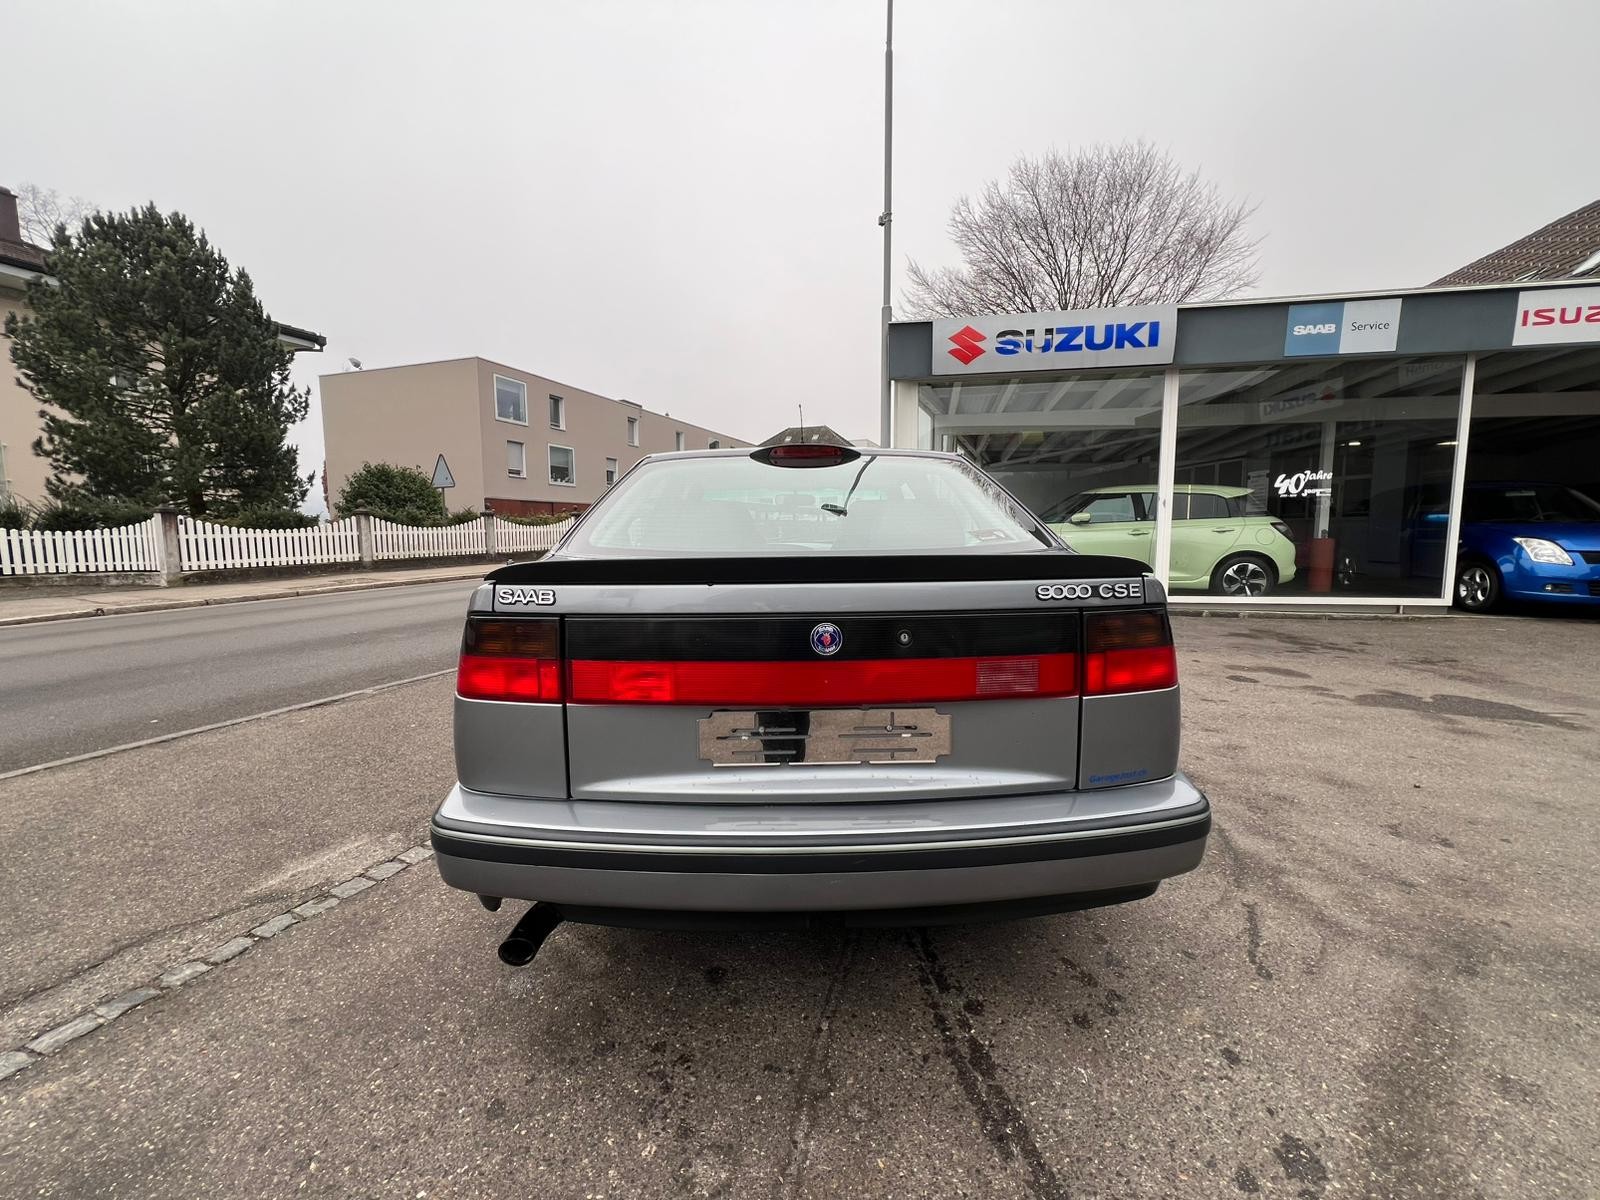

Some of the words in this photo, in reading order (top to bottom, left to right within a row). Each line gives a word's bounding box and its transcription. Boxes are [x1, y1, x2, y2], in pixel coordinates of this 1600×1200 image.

[1293, 323, 1336, 336] SAAB
[1351, 321, 1390, 332] Service
[995, 321, 1160, 355] SUZUKI
[1274, 472, 1306, 495] 40
[498, 588, 556, 606] SAAB
[1035, 584, 1092, 600] 9000
[1098, 583, 1142, 599] CSE
